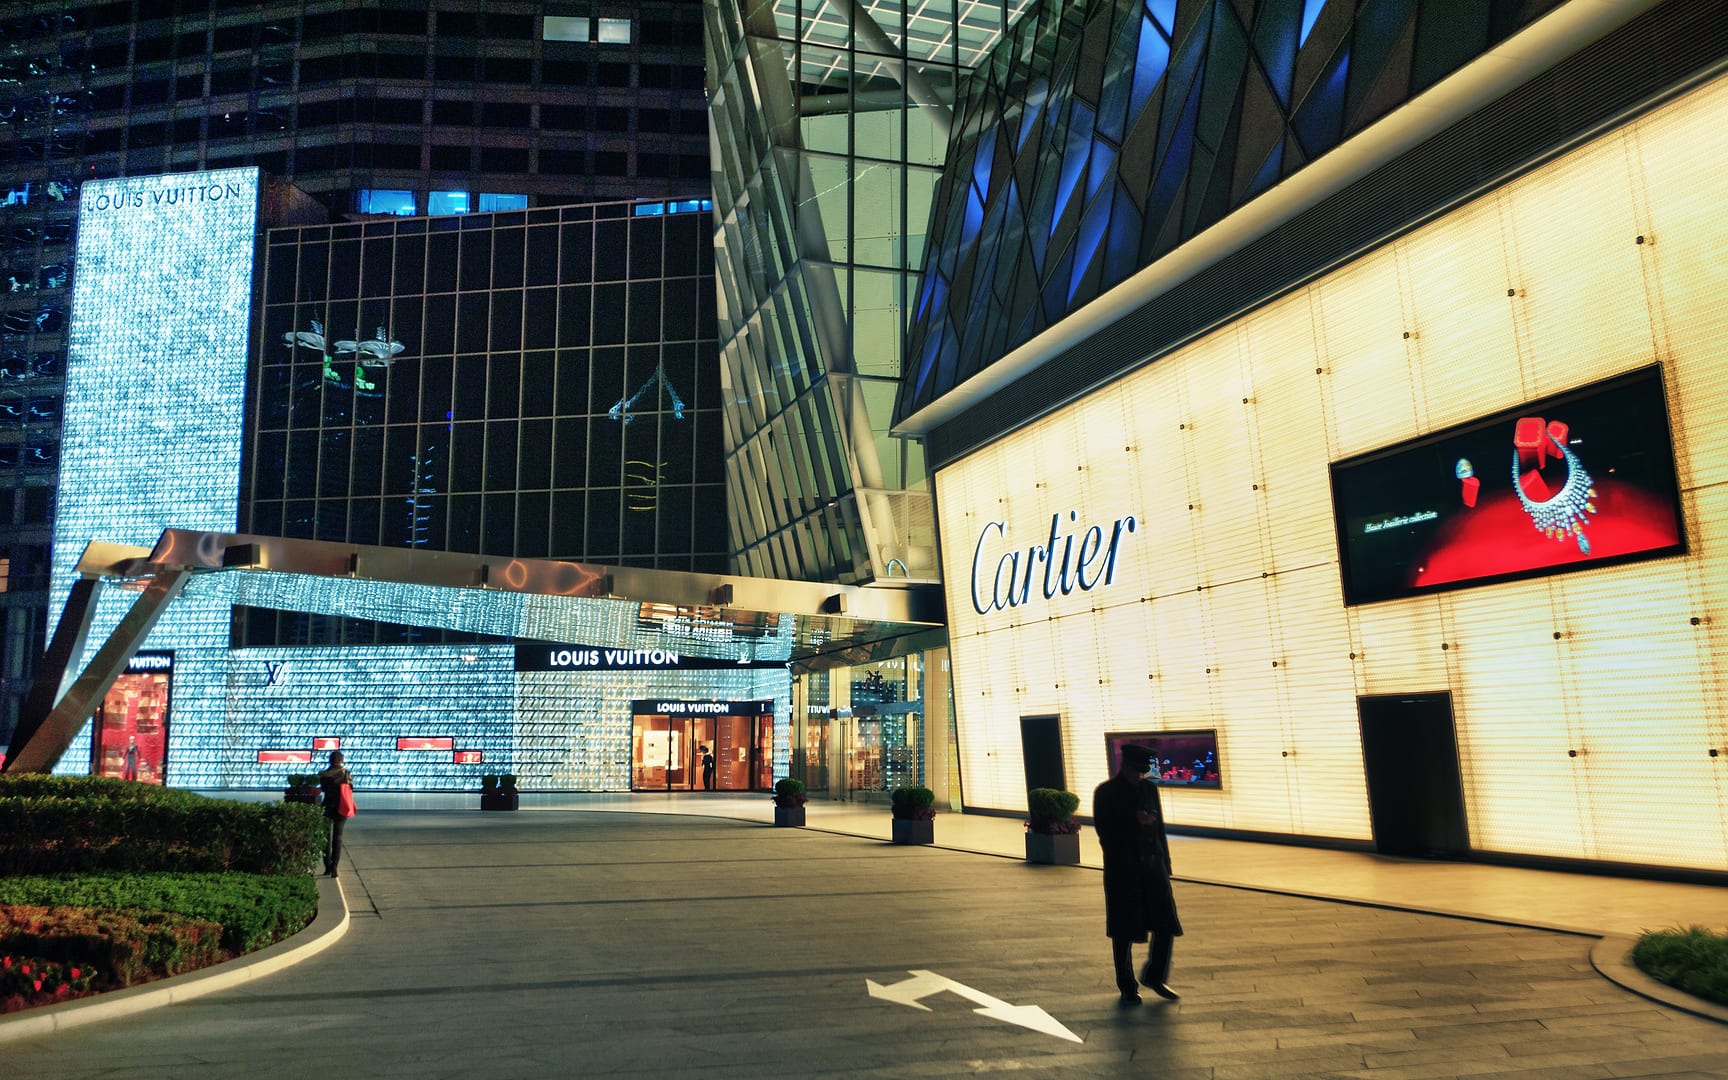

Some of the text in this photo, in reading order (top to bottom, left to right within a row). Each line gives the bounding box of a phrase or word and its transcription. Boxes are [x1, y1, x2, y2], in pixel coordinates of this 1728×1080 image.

[88, 184, 240, 212] LOUIS VUITTON
[971, 510, 1136, 615] Cartier
[129, 656, 171, 669] VUITTON
[550, 649, 679, 666] LOUIS VUITTON
[657, 702, 729, 713] LOUIS VUITTON
